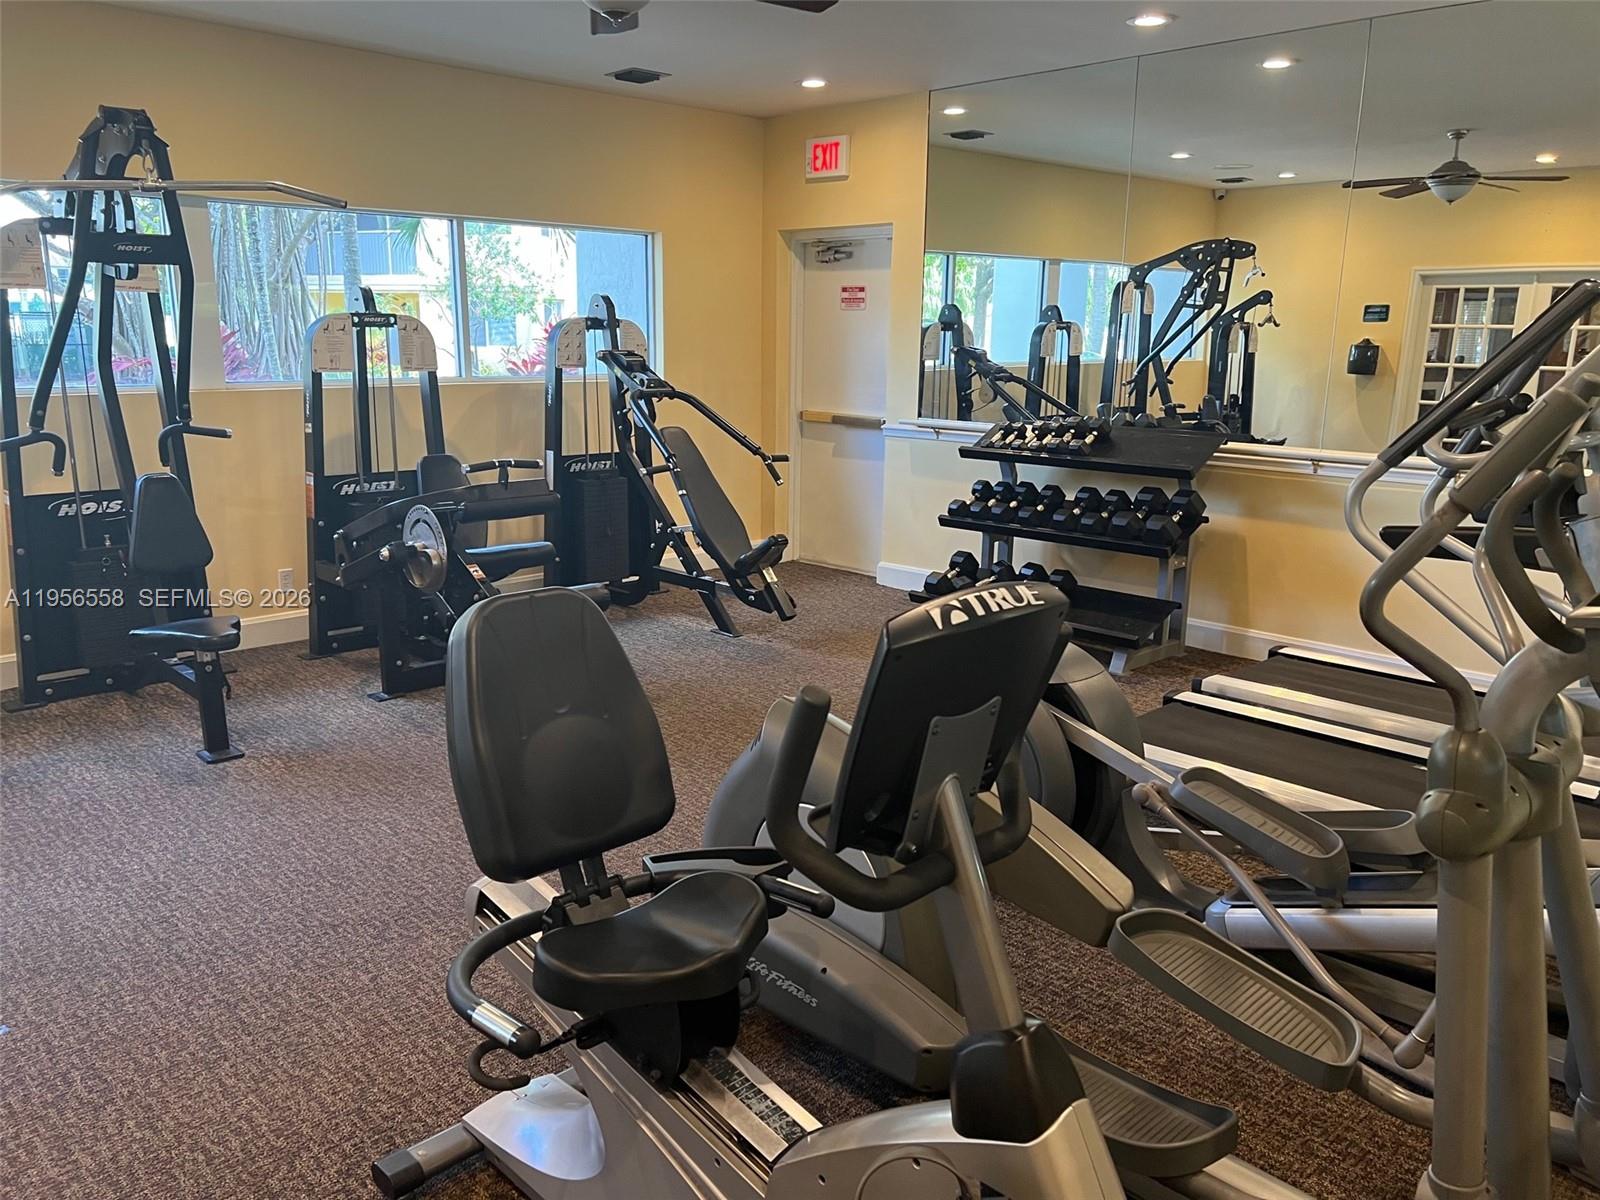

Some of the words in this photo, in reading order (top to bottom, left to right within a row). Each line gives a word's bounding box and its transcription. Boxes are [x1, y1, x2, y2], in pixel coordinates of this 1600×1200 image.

[812, 142, 840, 172] EXIT
[116, 244, 151, 253] HOIST
[57, 499, 134, 517] HOIS
[958, 584, 1046, 616] TRUE
